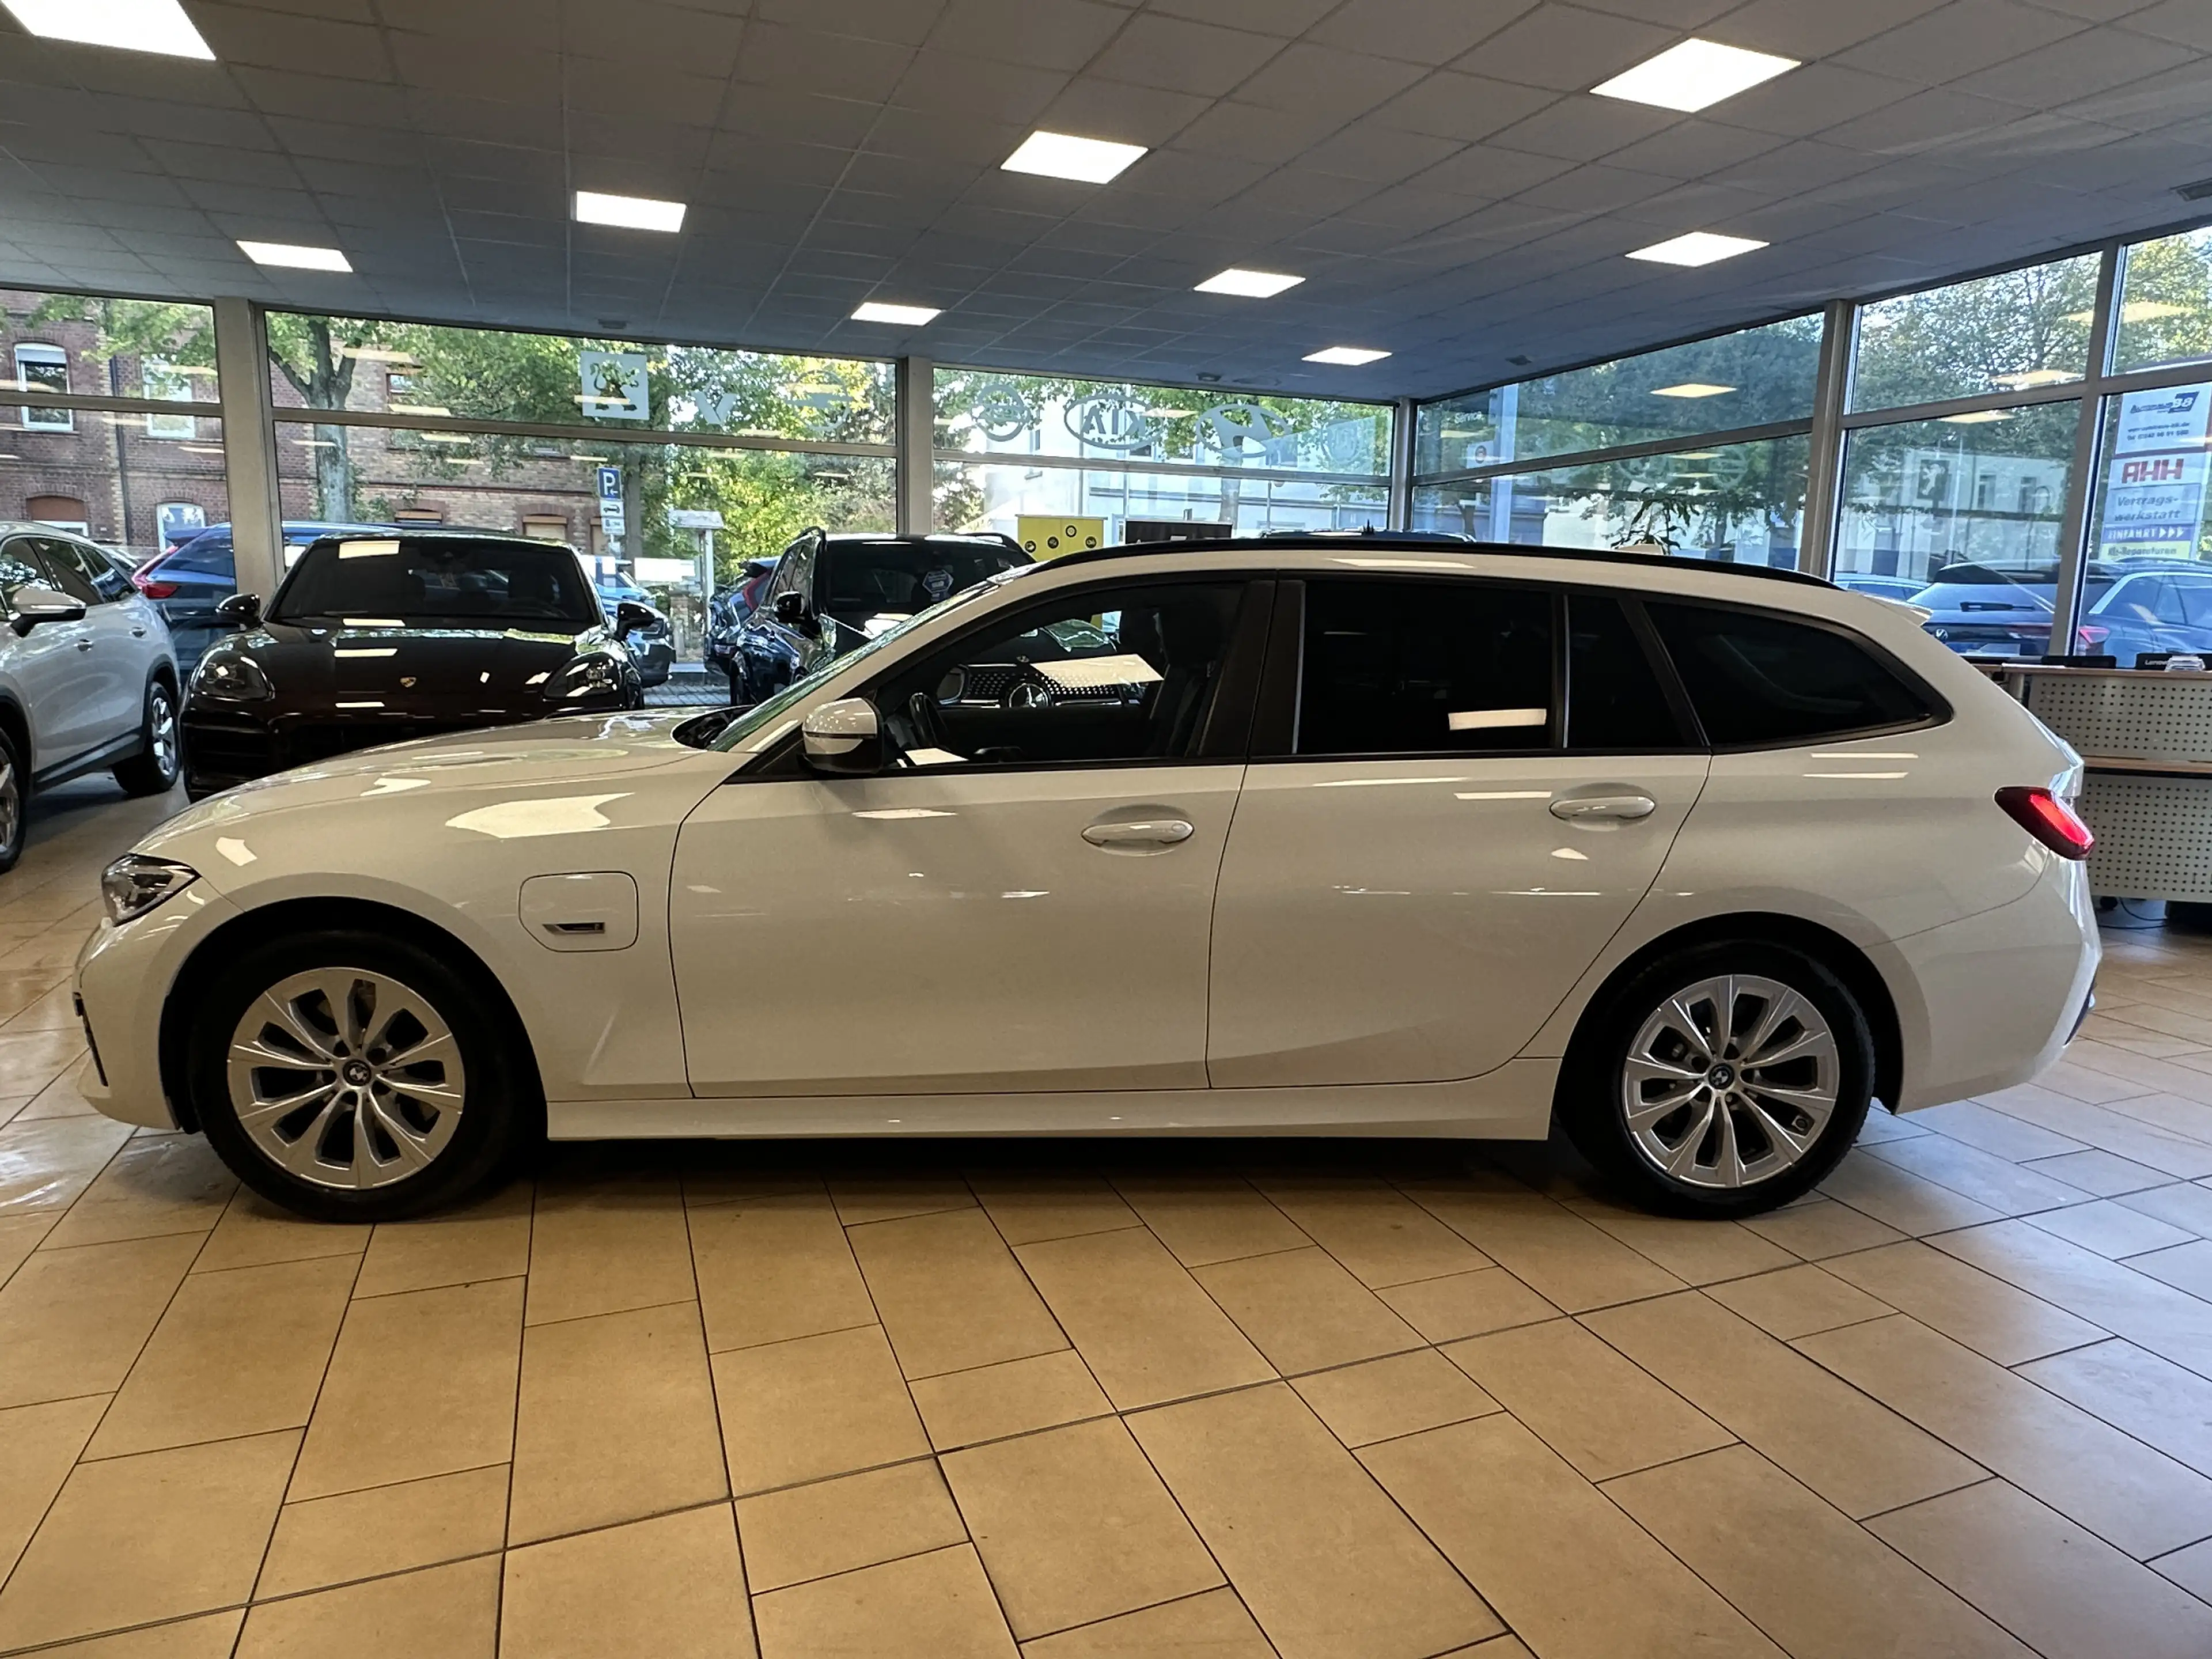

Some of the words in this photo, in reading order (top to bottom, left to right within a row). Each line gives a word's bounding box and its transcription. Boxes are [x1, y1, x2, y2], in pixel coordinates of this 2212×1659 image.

[2122, 459, 2184, 484] AHH
[603, 472, 616, 495] P
[2118, 495, 2179, 506] Vertrags-
[2114, 510, 2181, 521] werkstatt
